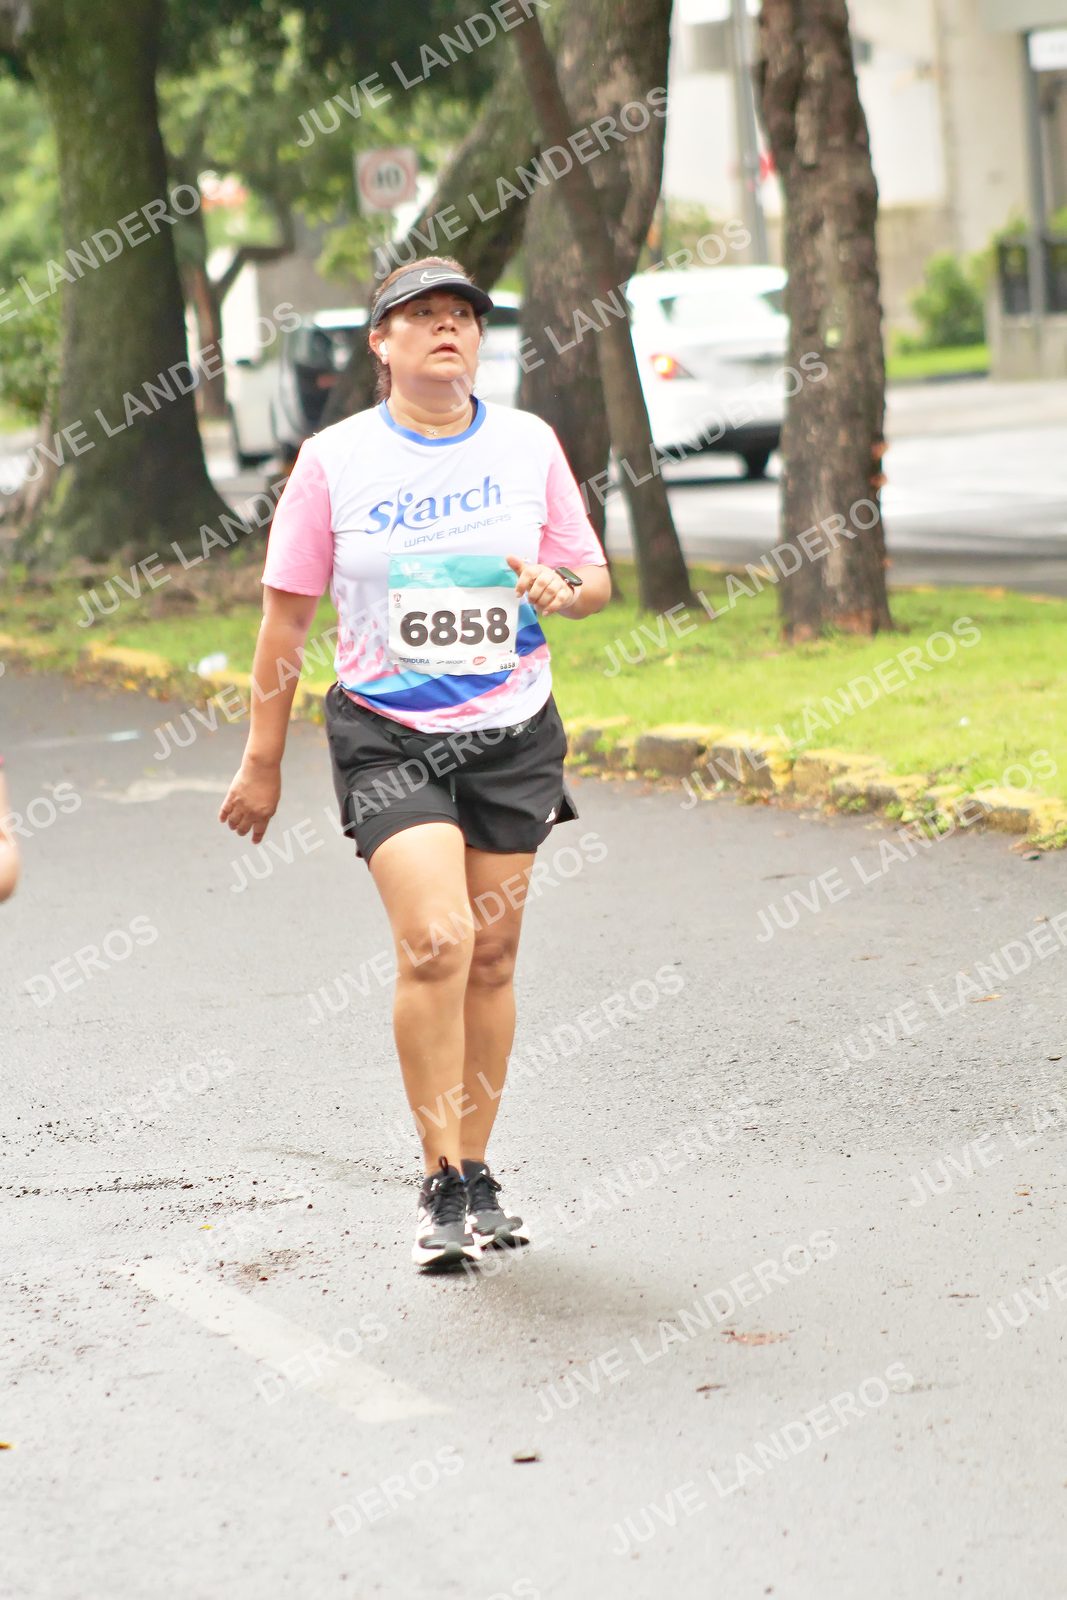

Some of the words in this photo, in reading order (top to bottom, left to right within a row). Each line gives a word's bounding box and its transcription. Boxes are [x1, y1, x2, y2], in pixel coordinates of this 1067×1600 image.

[404, 530, 446, 547] WAVE
[449, 514, 511, 536] RUNNERS
[400, 607, 510, 647] 6858
